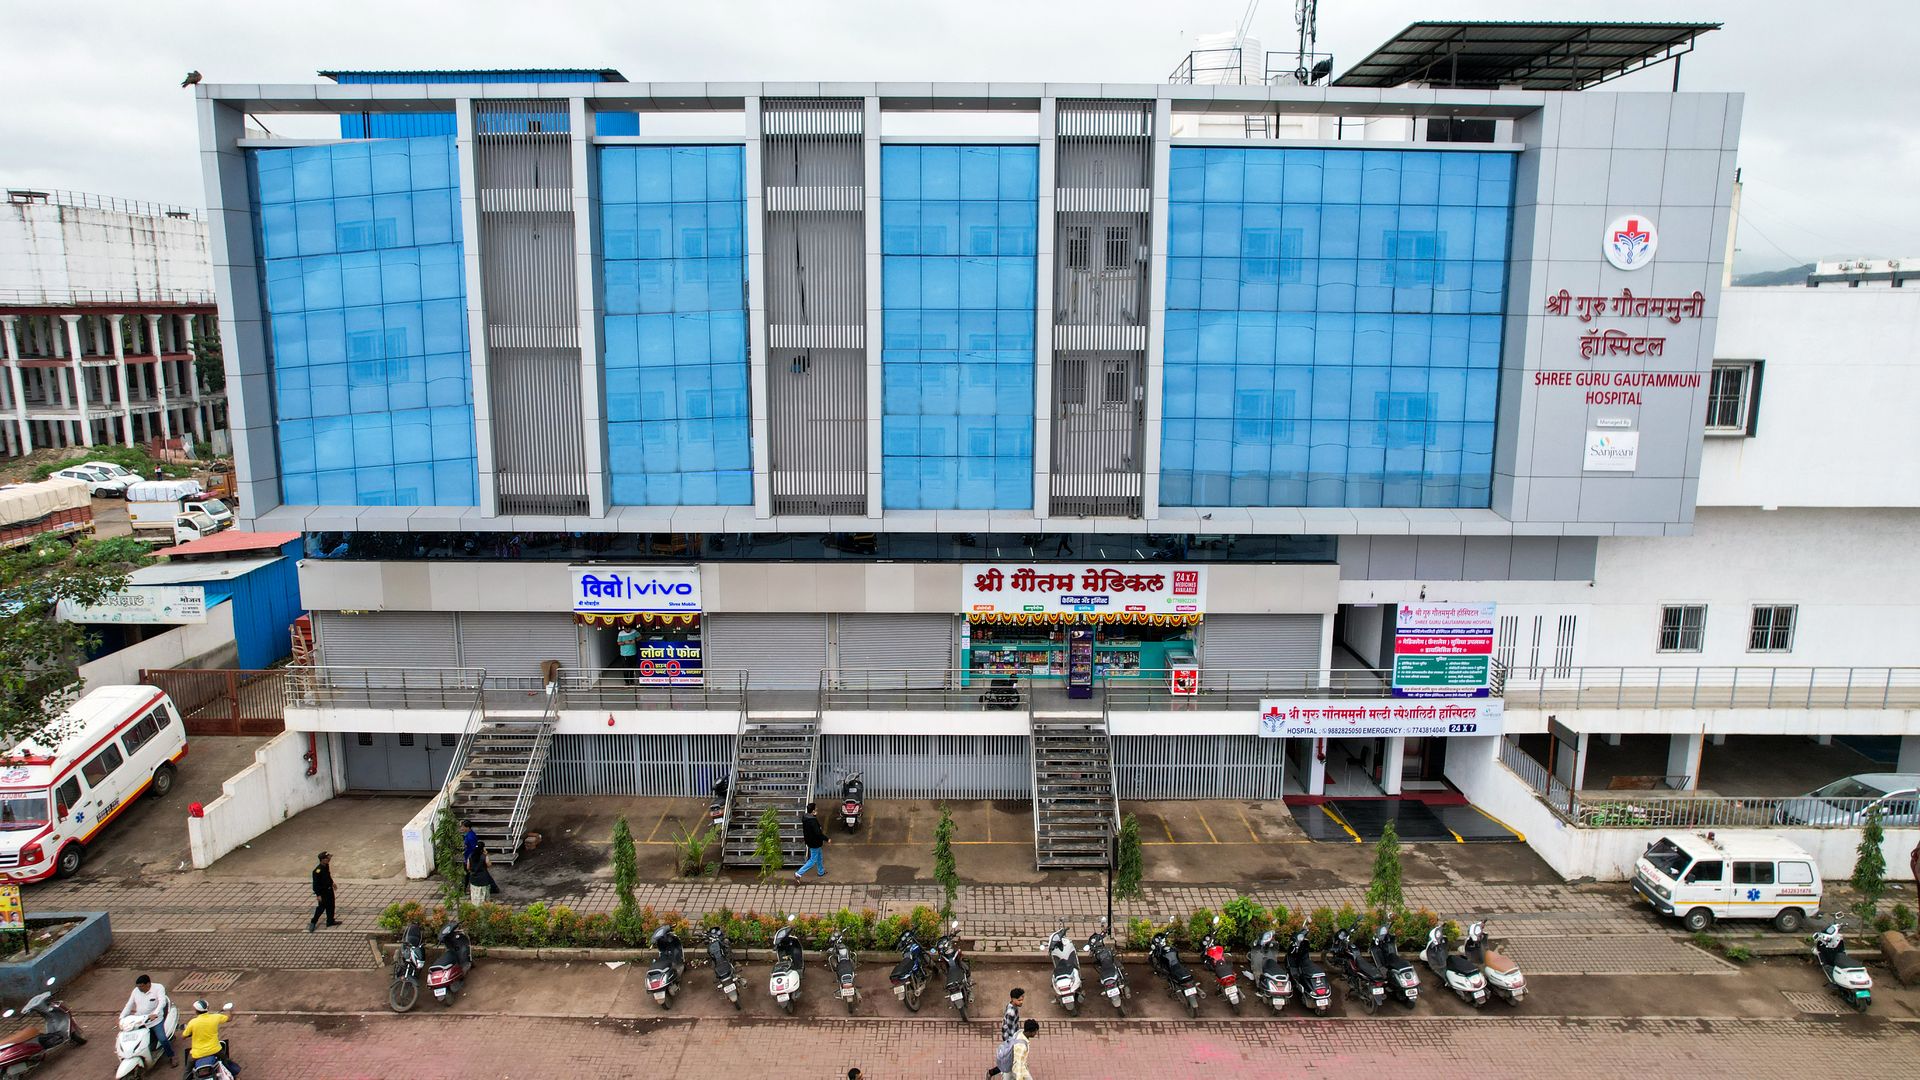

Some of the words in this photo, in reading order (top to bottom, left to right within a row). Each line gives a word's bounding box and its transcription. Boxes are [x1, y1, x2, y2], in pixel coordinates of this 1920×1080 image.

[1545, 289, 1572, 317] श्री
[1577, 296, 1607, 322] गुरु
[1612, 288, 1705, 324] गौतममुनी
[1580, 329, 1666, 360] हॉस्पिटल
[1535, 372, 1572, 386] SHREE
[1576, 372, 1610, 387] GURU
[1614, 373, 1701, 388] GAUTAMMUNI
[1585, 391, 1642, 405] HOSPITAL
[974, 568, 1004, 594] श्री
[1011, 568, 1075, 593] गौतम
[1082, 568, 1165, 594] मेडिकल
[1176, 572, 1185, 582] 24
[1192, 572, 1197, 582] 7
[581, 574, 623, 598] विवो
[634, 579, 692, 595] vivo
[640, 645, 665, 658] लोन
[666, 645, 675, 658] पे
[676, 645, 700, 658] फोन
[1289, 706, 1299, 719] श्री
[1302, 709, 1319, 724] गुरु
[1369, 706, 1391, 720] मल्टी
[1394, 705, 1436, 720] स्पेशालिटी
[1439, 704, 1476, 720] हॉस्पिटल
[1451, 724, 1462, 732] 24
[1470, 724, 1475, 732] 7
